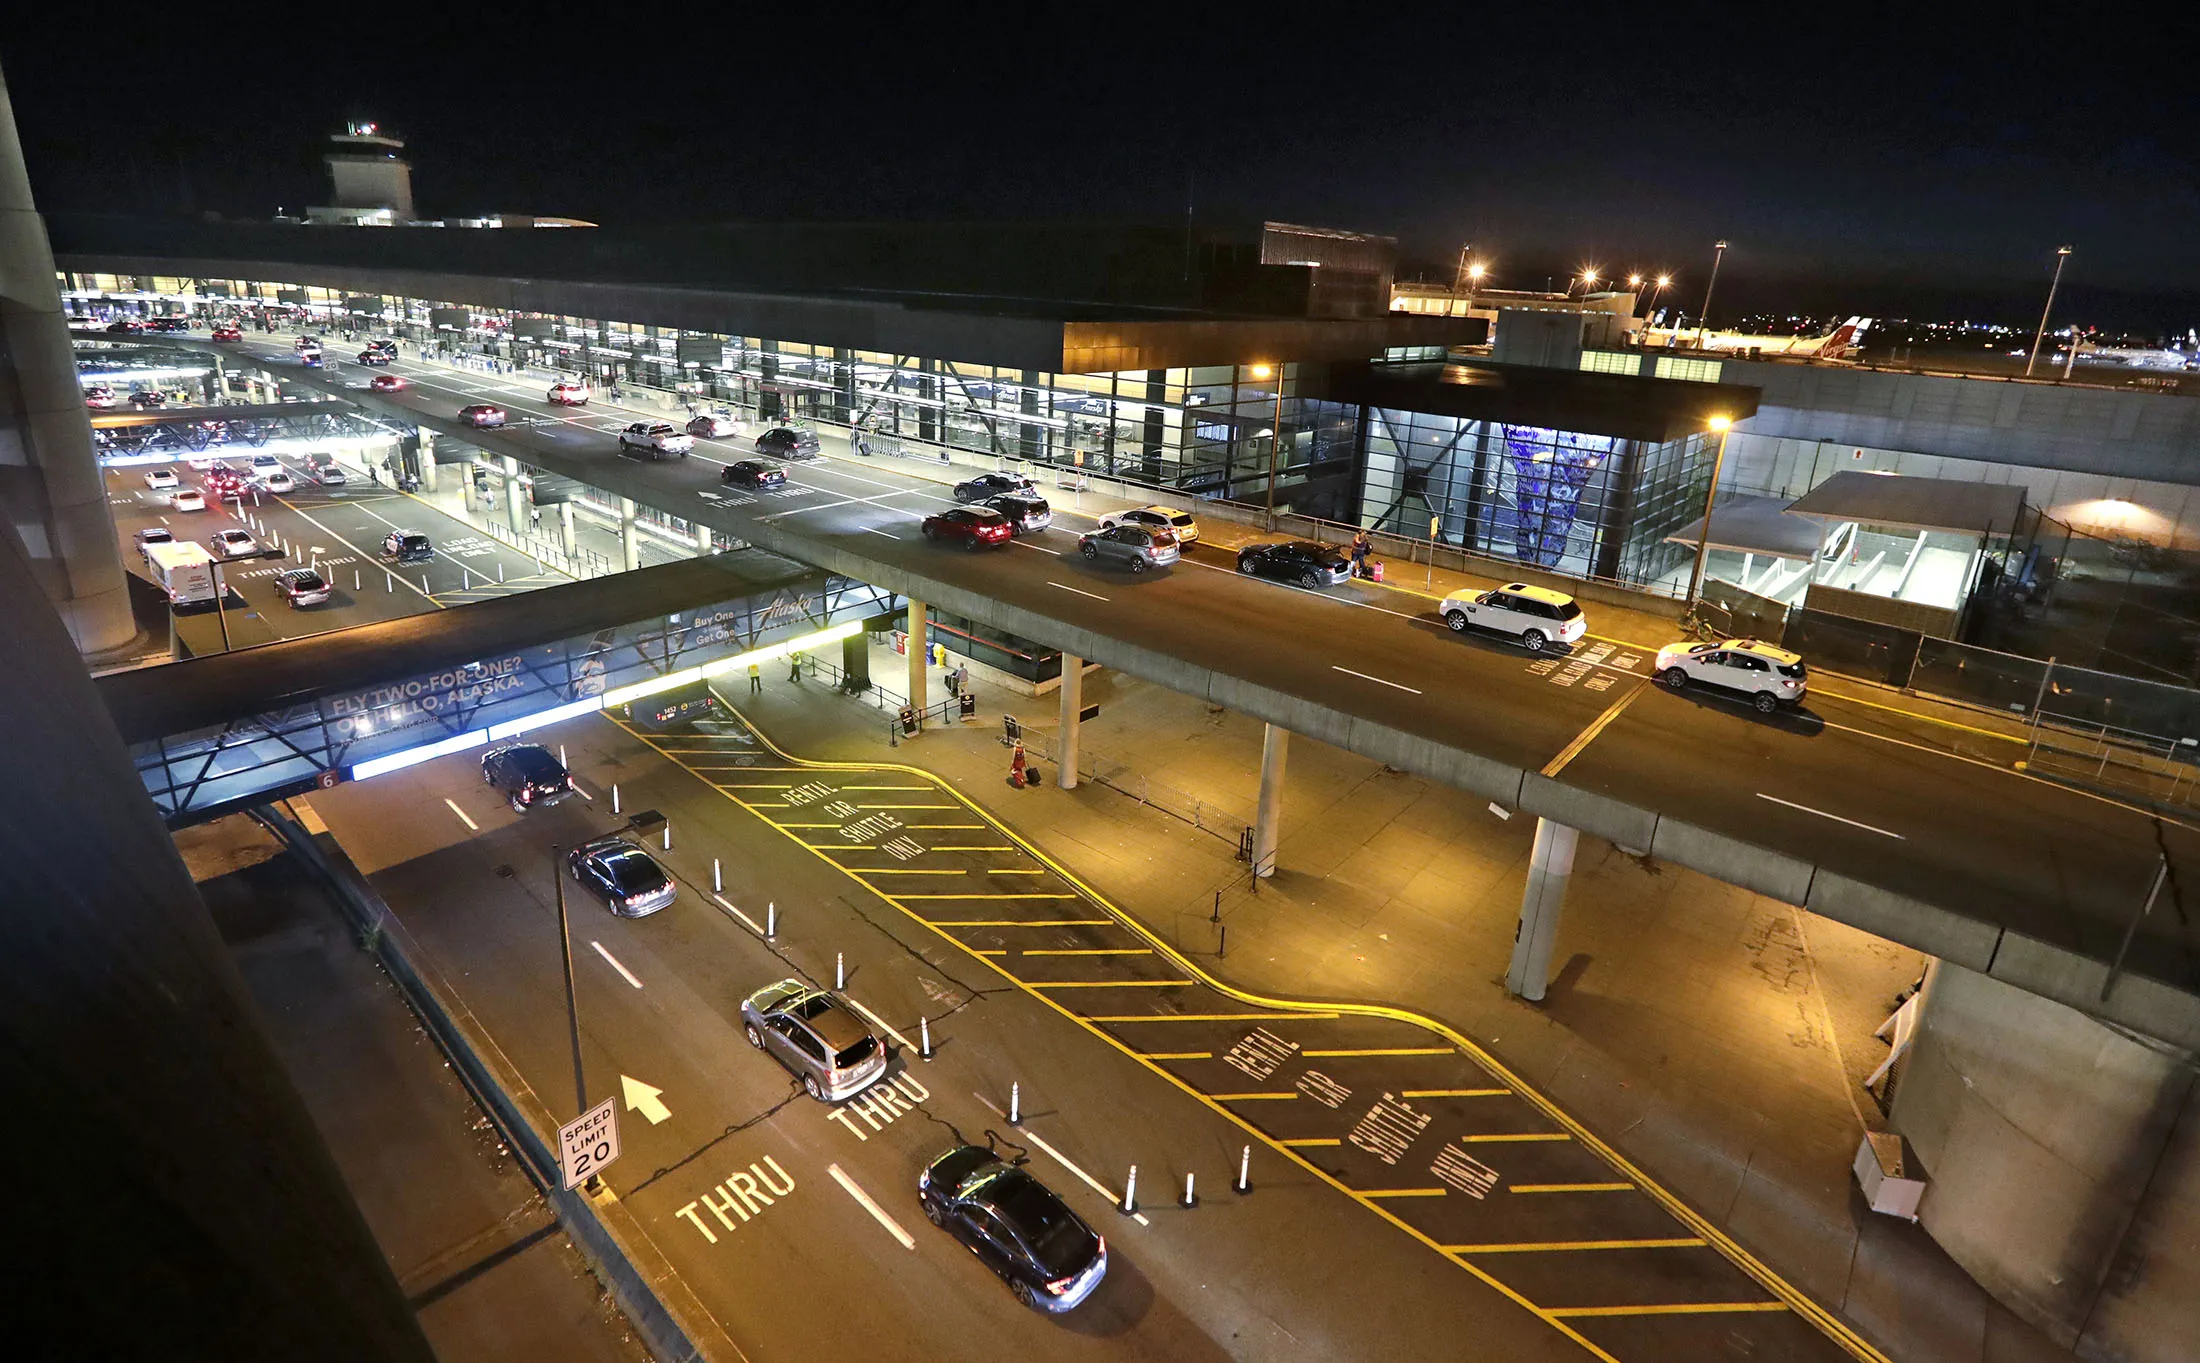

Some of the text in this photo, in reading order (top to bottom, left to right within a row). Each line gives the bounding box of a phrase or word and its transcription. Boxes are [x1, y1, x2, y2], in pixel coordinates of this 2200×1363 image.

[705, 496, 758, 508] THRU
[765, 487, 815, 498] THRU
[442, 536, 479, 547] LOAD
[443, 540, 496, 553] UNLOAD
[461, 546, 496, 558] ONLY
[237, 567, 285, 579] THRU
[314, 557, 356, 568] THRU
[694, 611, 735, 628] Buy One
[757, 594, 813, 622] Alaska
[696, 634, 714, 645] Get
[715, 629, 736, 640] One
[1525, 659, 1560, 676] LOAD
[332, 656, 522, 716] FLY TWO-FOR-ONE?
[447, 675, 525, 705] ALASKA.
[1584, 672, 1618, 692] ONLY
[664, 705, 677, 714] 1452
[323, 775, 334, 788] 6
[781, 781, 839, 807] RENTAL
[824, 801, 860, 819] CAR
[839, 811, 904, 844] SHUTTLE
[882, 835, 926, 861] ONLY
[1222, 1027, 1300, 1081] RENTAL
[1296, 1070, 1352, 1108] CAR
[826, 1070, 930, 1141] THRU
[565, 1108, 611, 1142] SPEED
[1348, 1091, 1432, 1165] SHUTTLE
[571, 1125, 608, 1154] LIMIT
[574, 1141, 610, 1177] 20
[1430, 1143, 1500, 1200] ONLY
[675, 1155, 796, 1244] THRU
